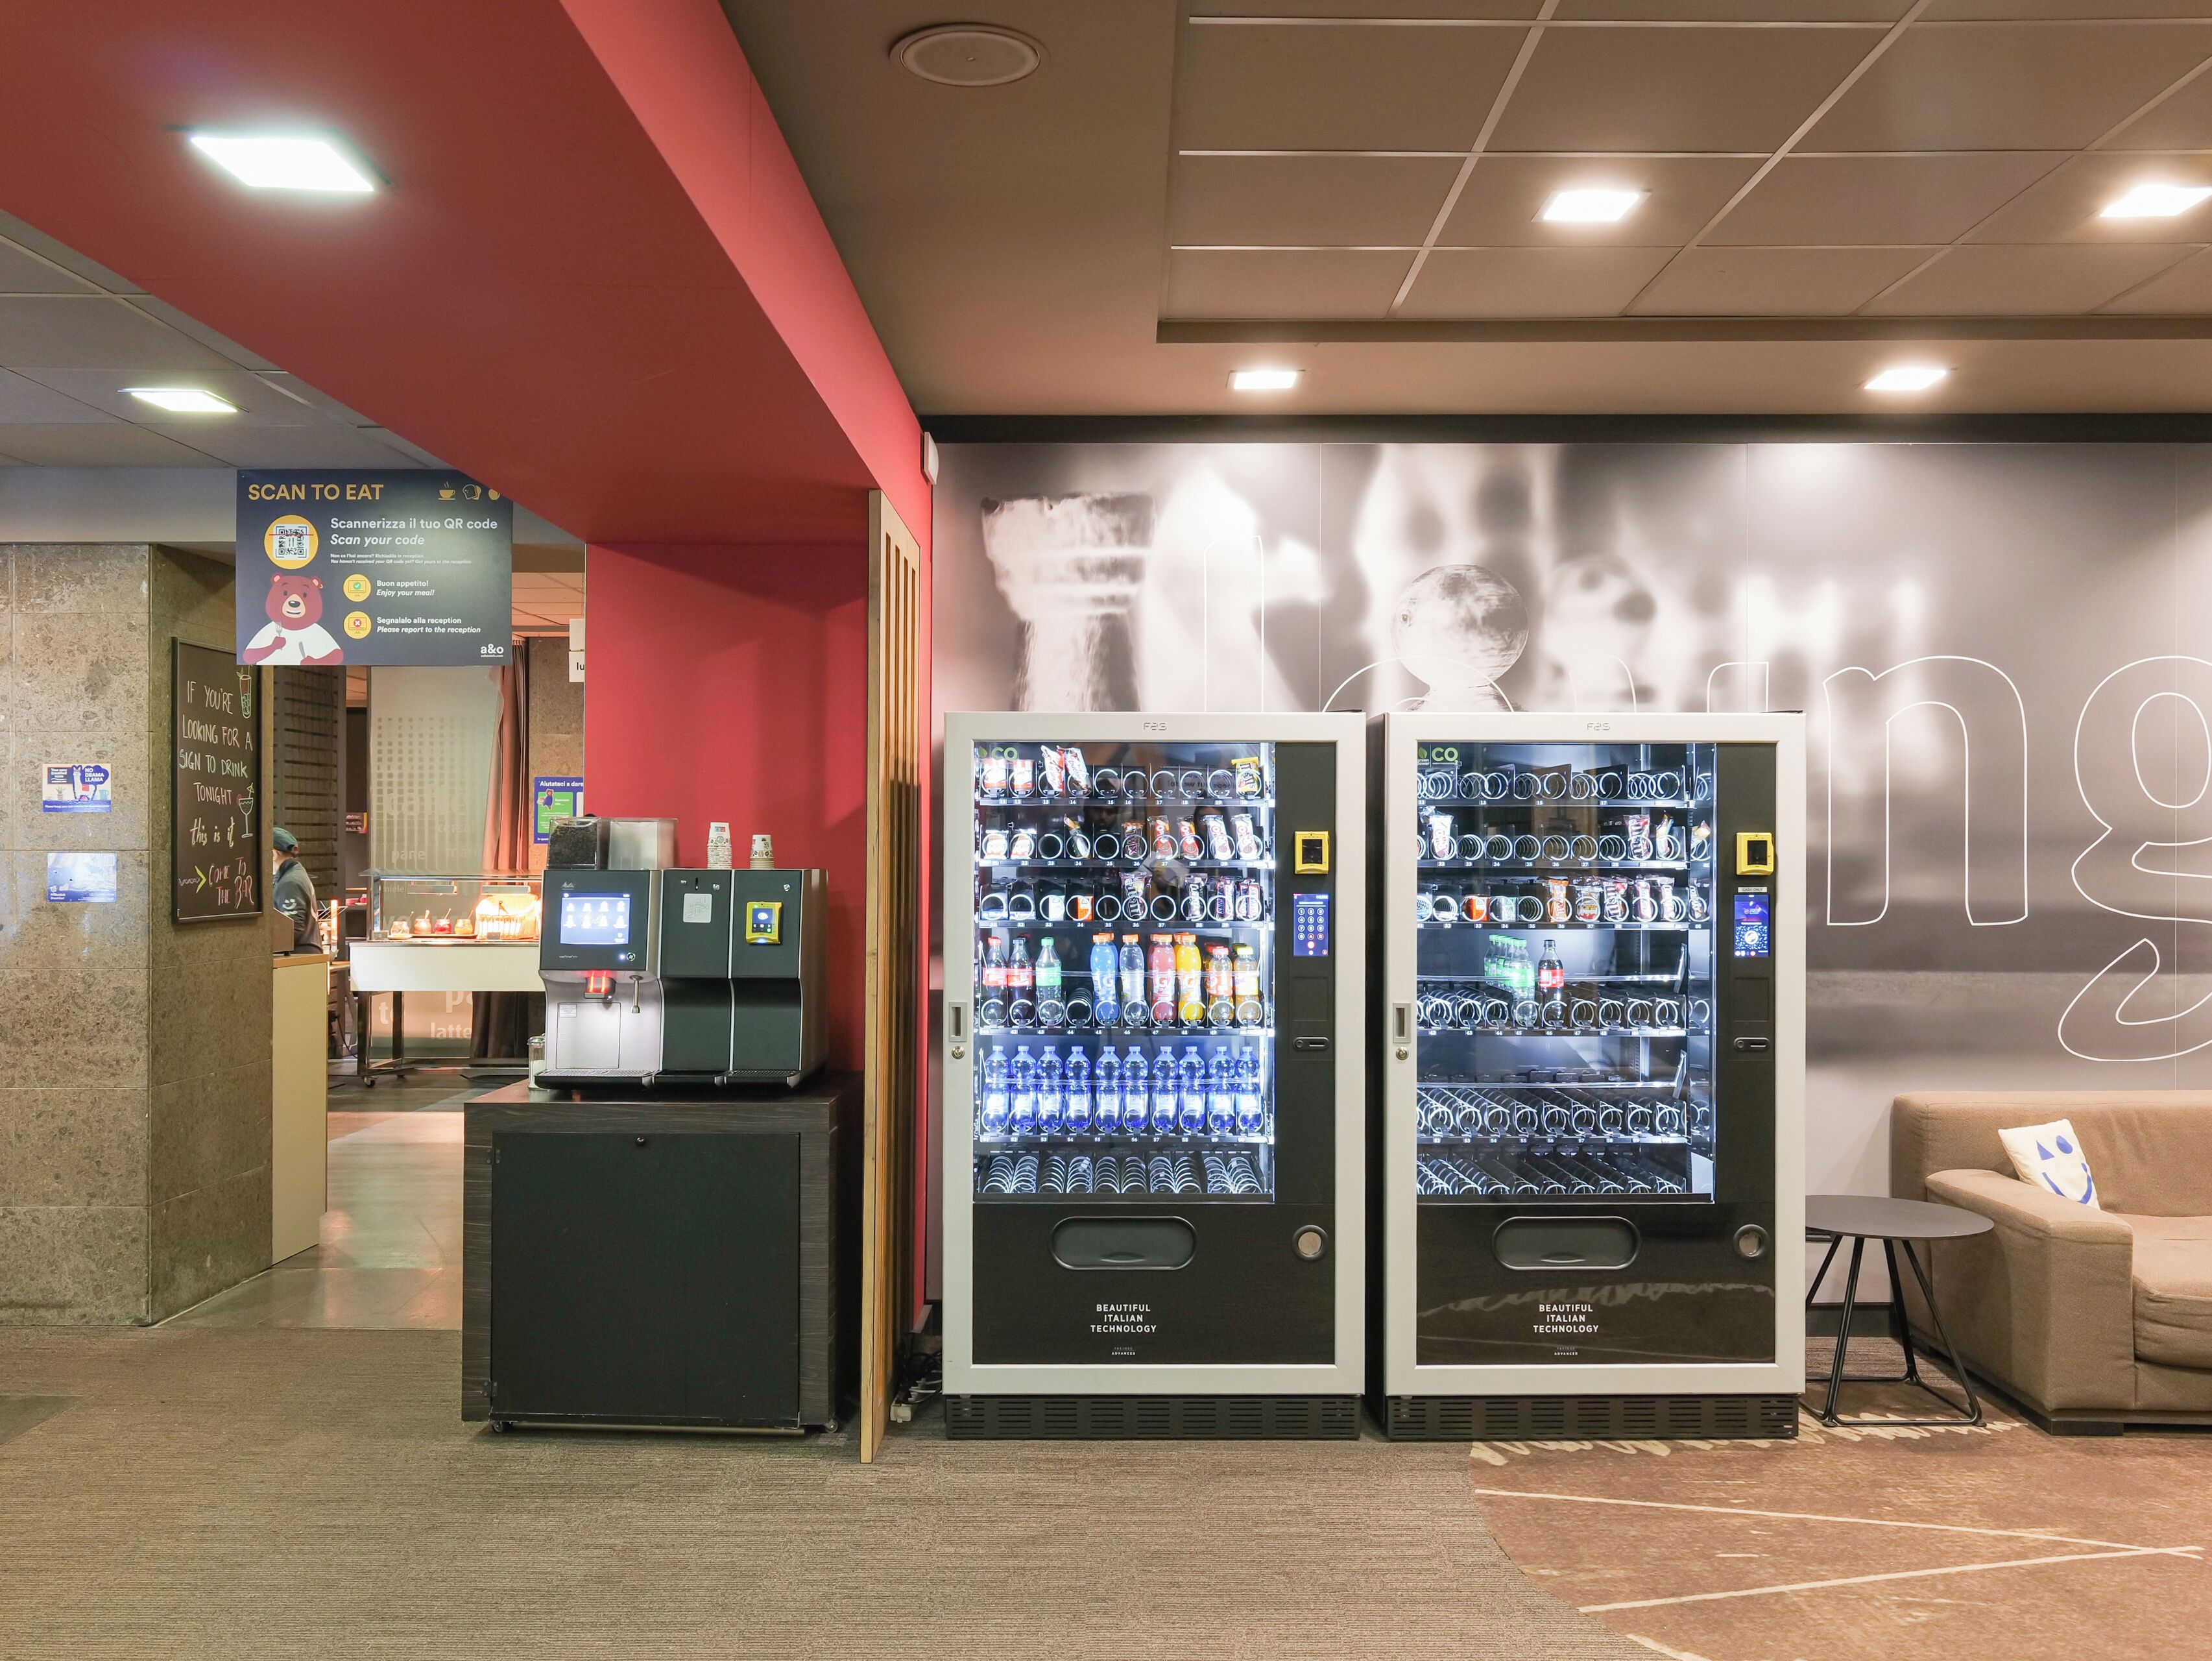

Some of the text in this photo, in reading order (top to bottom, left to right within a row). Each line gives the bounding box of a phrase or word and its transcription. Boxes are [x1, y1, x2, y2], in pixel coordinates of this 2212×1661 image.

[248, 484, 384, 500] SCAN TO EAT
[330, 518, 498, 529] Scannerizza il tuo QR code
[330, 534, 425, 547] Scan your code
[480, 643, 504, 654] a&o
[187, 681, 234, 714] IF YOU'RE
[183, 714, 253, 751] LOOKING FOR A
[179, 749, 248, 779] SIGN TO DRINK
[193, 782, 232, 805] TONIGHT
[189, 816, 235, 847] this is it
[391, 849, 426, 863] pane
[209, 856, 246, 887] COME TO
[215, 875, 254, 909] THE BAR
[431, 1022, 472, 1039] latte
